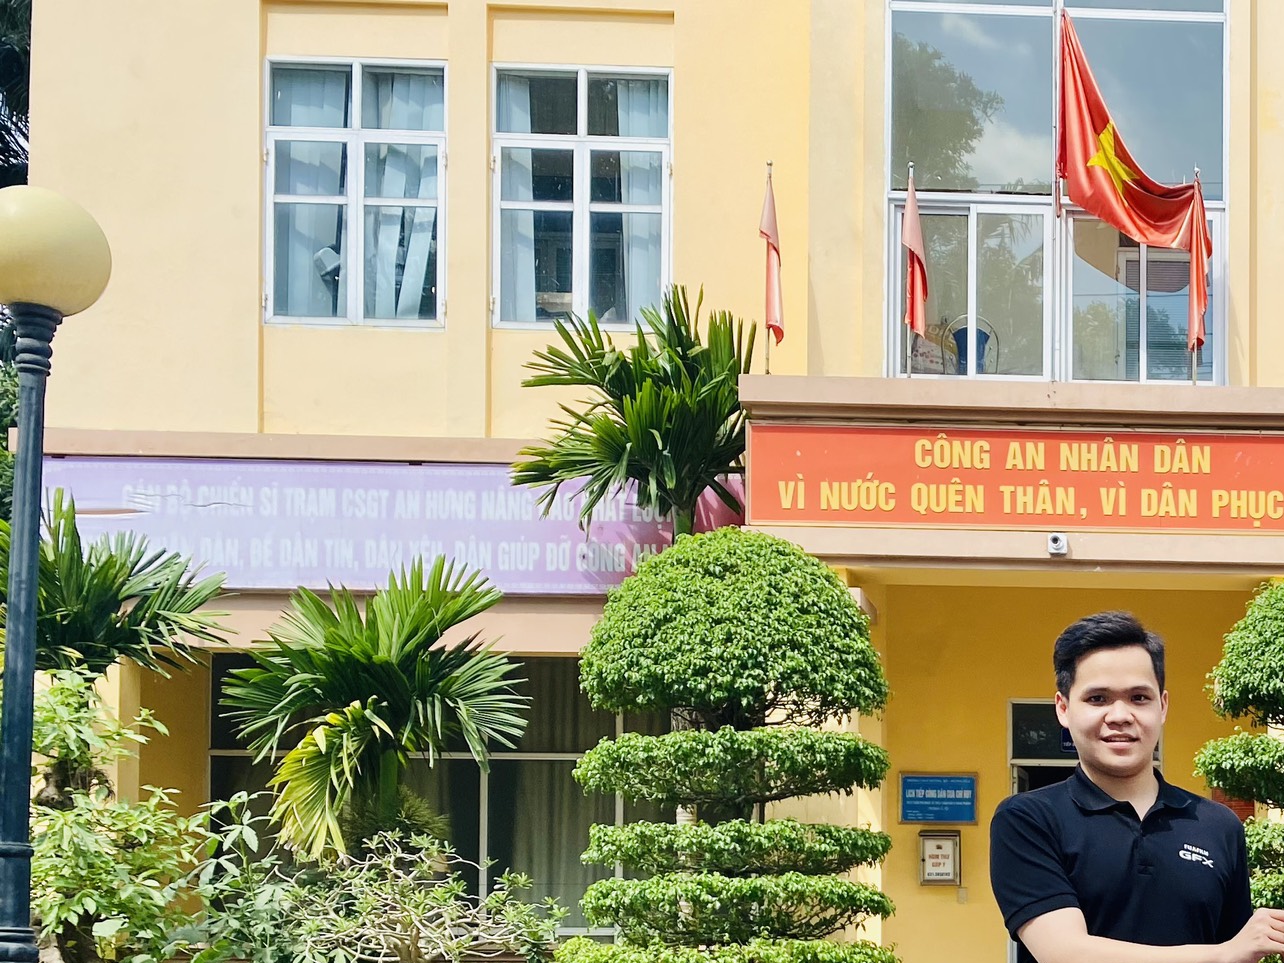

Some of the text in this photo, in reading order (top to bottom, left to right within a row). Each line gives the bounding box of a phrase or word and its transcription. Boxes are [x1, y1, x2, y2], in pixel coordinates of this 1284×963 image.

[914, 433, 1211, 474] CÔNG AN NHÂN DÂN
[283, 487, 337, 524] TRẠM
[341, 488, 390, 519] CSGT
[394, 489, 420, 520] AN
[481, 484, 533, 521] NÂNG
[777, 473, 805, 510] VÌ
[819, 471, 896, 511] NƯỚC
[910, 477, 985, 515] QUÊN
[999, 478, 1088, 519] THÂN,
[1099, 480, 1127, 516] VÌ
[1140, 482, 1198, 517] DÂN
[1211, 489, 1284, 528] PHỤC
[279, 531, 319, 568] DÂN
[454, 535, 493, 571] DÂN
[498, 535, 540, 571] GIÚP
[576, 537, 626, 572] CÔNG
[1179, 850, 1214, 868] GFX
